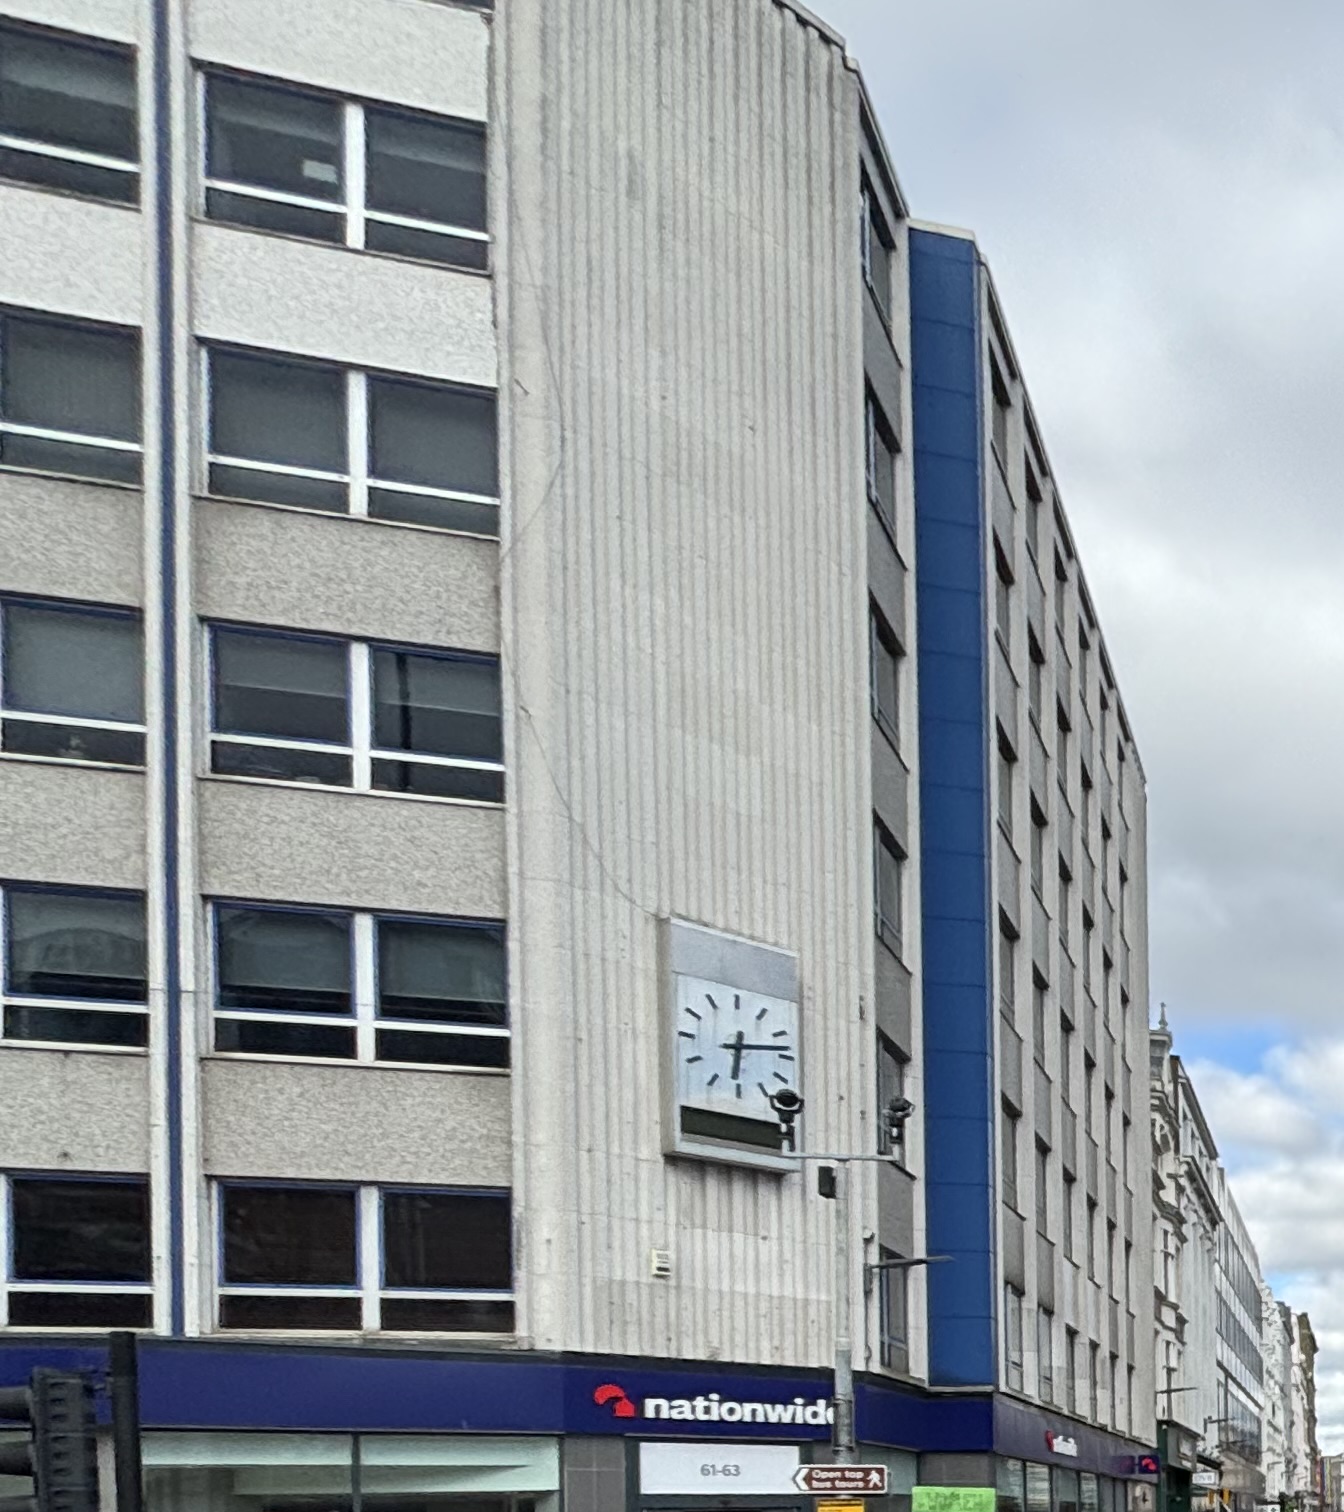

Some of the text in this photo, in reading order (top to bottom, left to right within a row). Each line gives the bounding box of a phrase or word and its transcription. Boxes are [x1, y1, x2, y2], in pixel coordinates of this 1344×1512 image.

[700, 1464, 741, 1477] 61-63
[812, 1469, 865, 1480] Open top
[812, 1479, 865, 1488] bus tours
